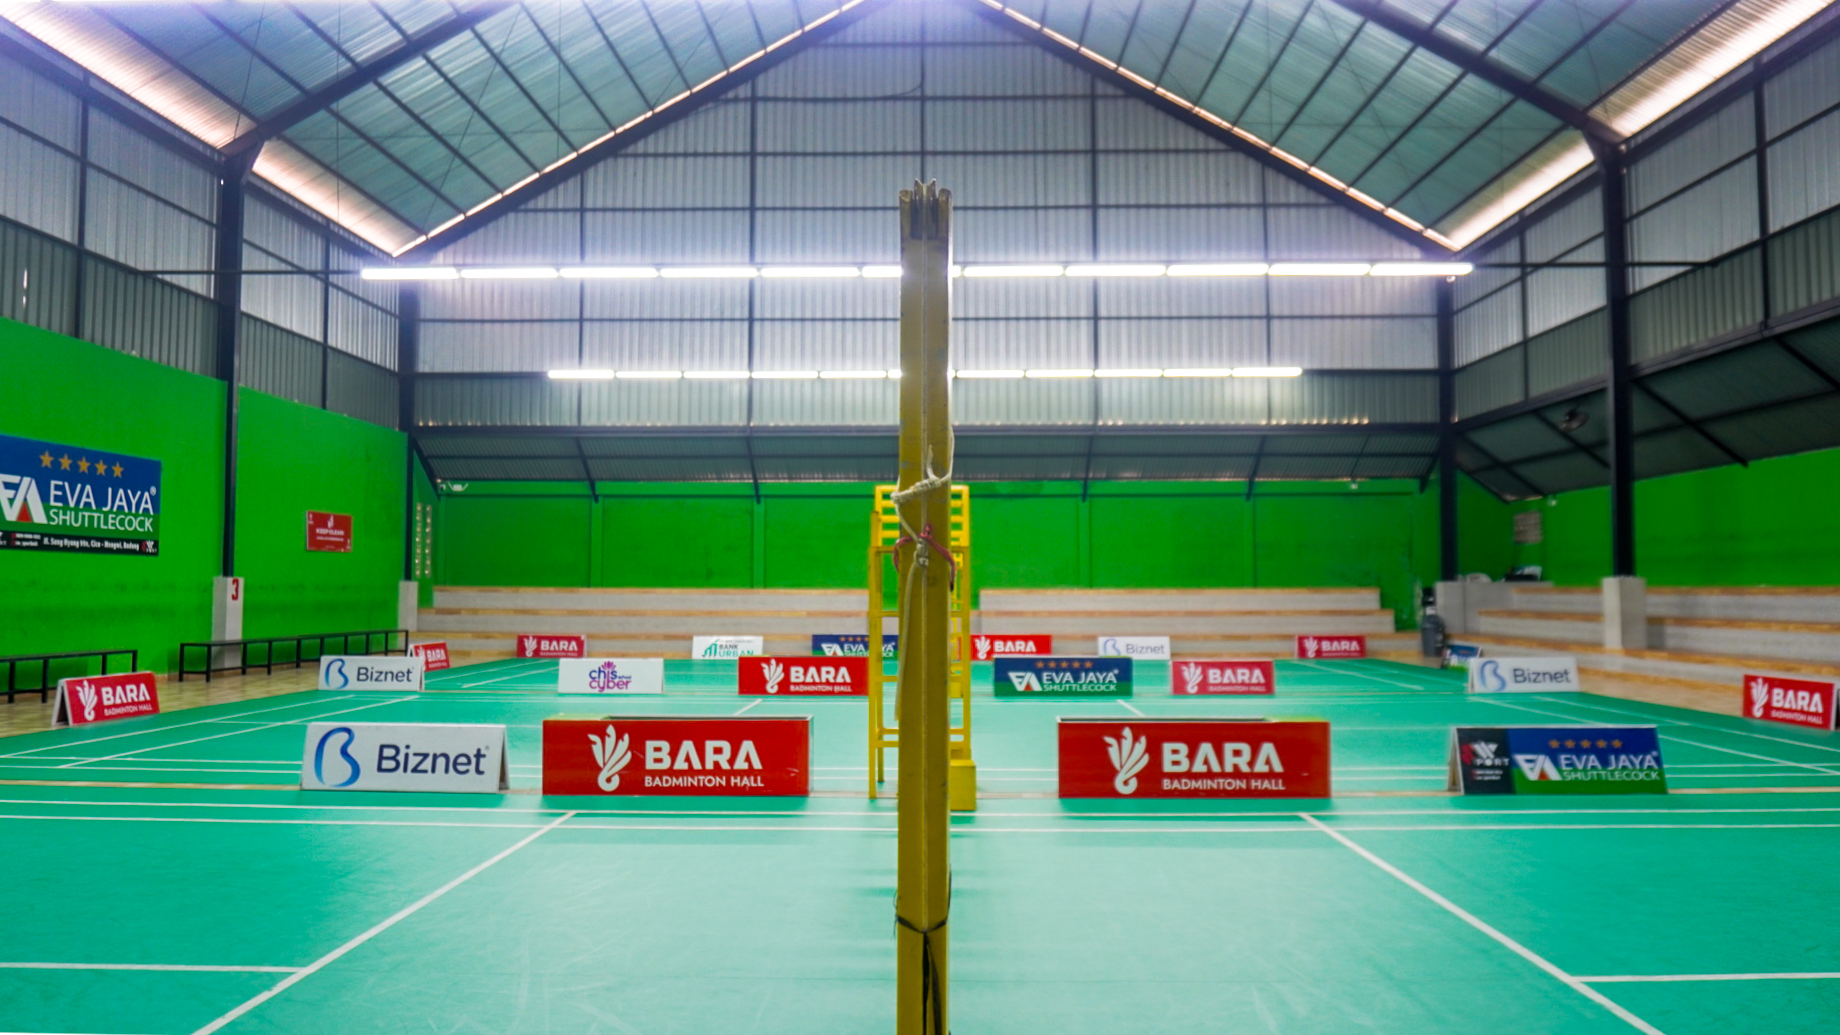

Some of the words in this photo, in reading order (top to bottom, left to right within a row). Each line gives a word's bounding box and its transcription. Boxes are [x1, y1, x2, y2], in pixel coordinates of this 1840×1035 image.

[50, 480, 97, 510] EVA
[49, 508, 154, 532] SHUTTLECOCK
[231, 578, 239, 600] 3
[541, 640, 578, 651] BARA
[844, 643, 866, 652] EVA
[994, 640, 1037, 652] BARA
[1126, 643, 1165, 654] Biznet
[1321, 640, 1360, 651] BARA
[427, 649, 447, 662] BARA
[356, 666, 413, 682] Biznet
[589, 666, 618, 680] chis
[790, 666, 852, 683] BARA
[1043, 672, 1075, 684] EVA
[1208, 668, 1266, 684] BARA
[1513, 668, 1571, 683] Biznet
[589, 679, 632, 693] cyber
[834, 685, 852, 693] HALL
[1043, 684, 1118, 692] SHUTTLECOCK
[101, 683, 151, 706] BARA
[1771, 688, 1824, 713] BARA
[104, 705, 138, 716] BADMINTON
[138, 703, 153, 711] HALL
[376, 744, 487, 775] Biznet
[645, 739, 763, 770] BARA
[1162, 742, 1285, 773] BARA
[1559, 755, 1602, 770] EVA
[644, 776, 726, 787] BADMINTON
[730, 776, 765, 788] HALL
[1562, 771, 1661, 781] SHUTTLECOCK
[1163, 779, 1247, 790] BADMINTON
[1250, 779, 1286, 790] HALL
